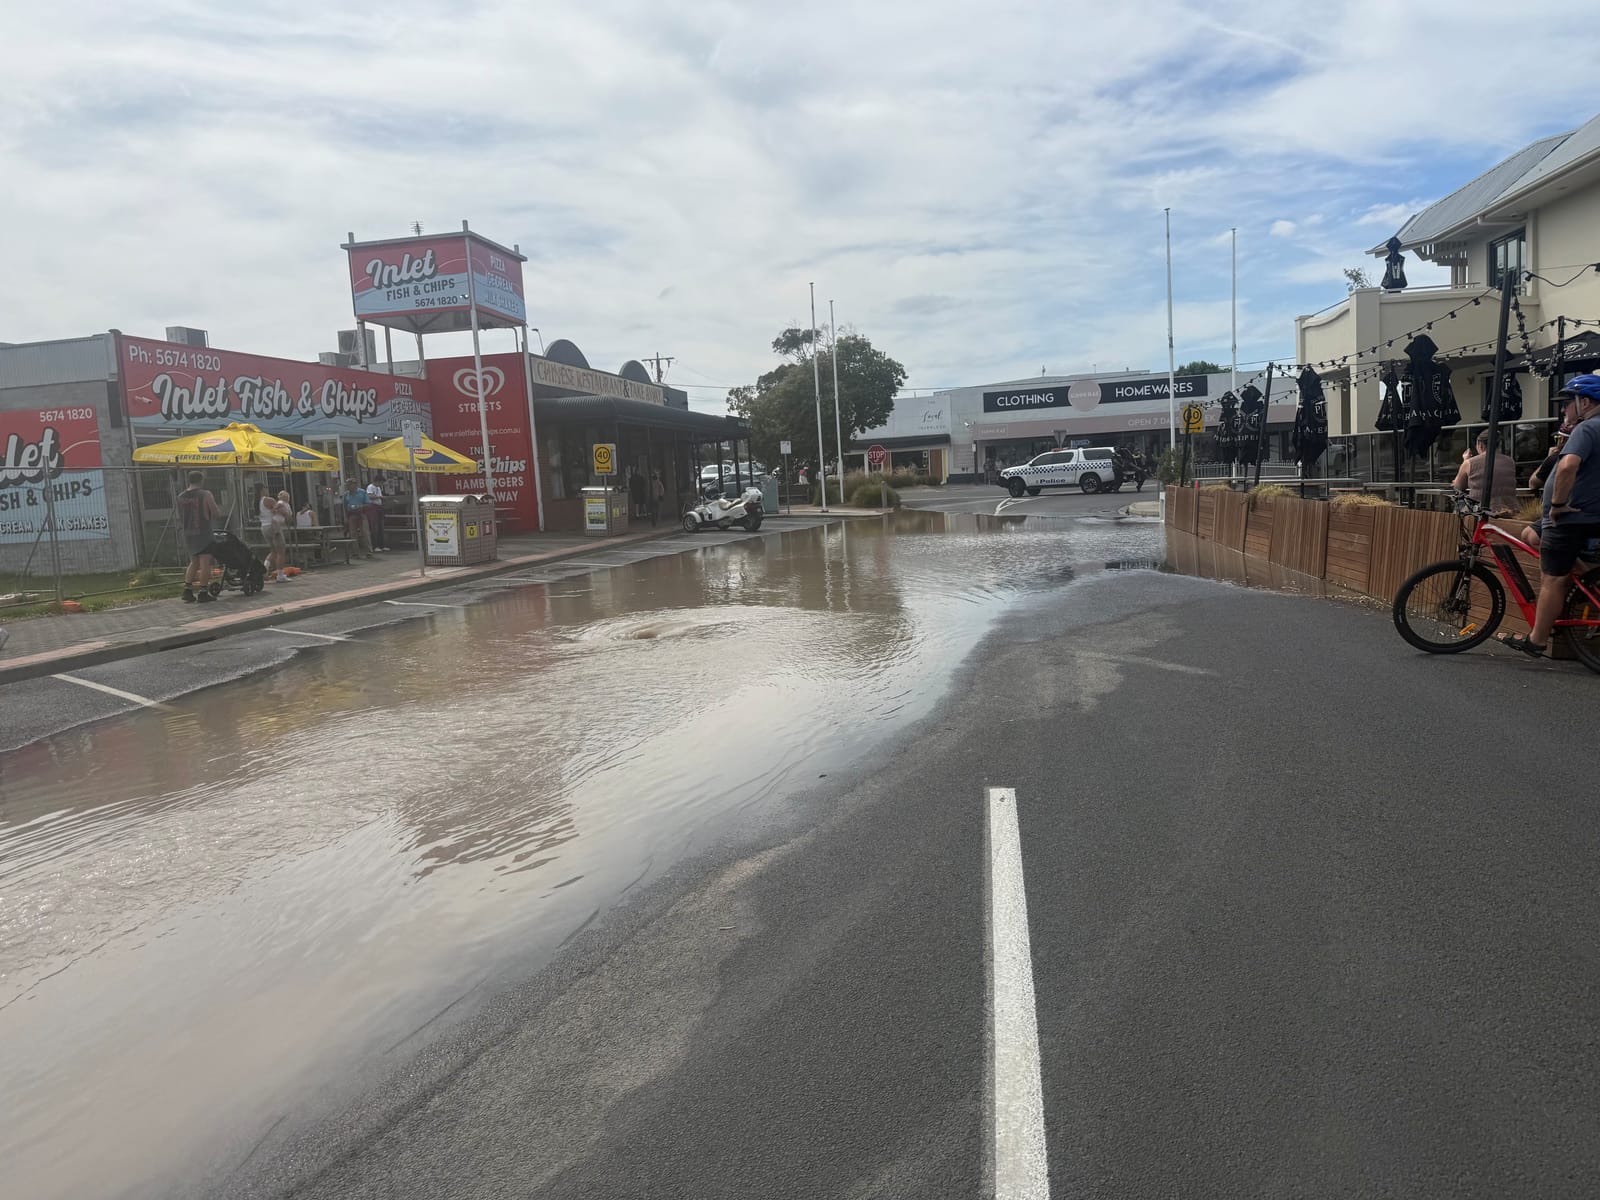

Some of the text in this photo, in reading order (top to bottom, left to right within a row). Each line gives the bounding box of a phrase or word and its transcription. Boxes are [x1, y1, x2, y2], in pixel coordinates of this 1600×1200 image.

[365, 249, 436, 288] Inlet
[386, 278, 455, 301] FISH & CHIPS
[415, 295, 458, 308] 5674 1820
[129, 345, 221, 371] Ph: 5674 1820
[537, 361, 575, 386] CHINESE
[623, 379, 630, 398] &
[152, 374, 377, 421] Inlet Fish & Chips
[1115, 382, 1193, 398] HOMEWARES
[996, 393, 1054, 406] CLOTHING
[40, 408, 92, 422] 5674 1820
[1160, 416, 1181, 425] DAS
[0, 427, 61, 481] let
[469, 445, 497, 456] INLT
[597, 450, 608, 460] 40
[868, 450, 885, 459] STOP
[488, 456, 526, 474] Chips
[455, 476, 524, 490] HAMBRGERS
[26, 489, 38, 507] &
[42, 478, 92, 503] CHIPS
[66, 514, 108, 531] SHAKES
